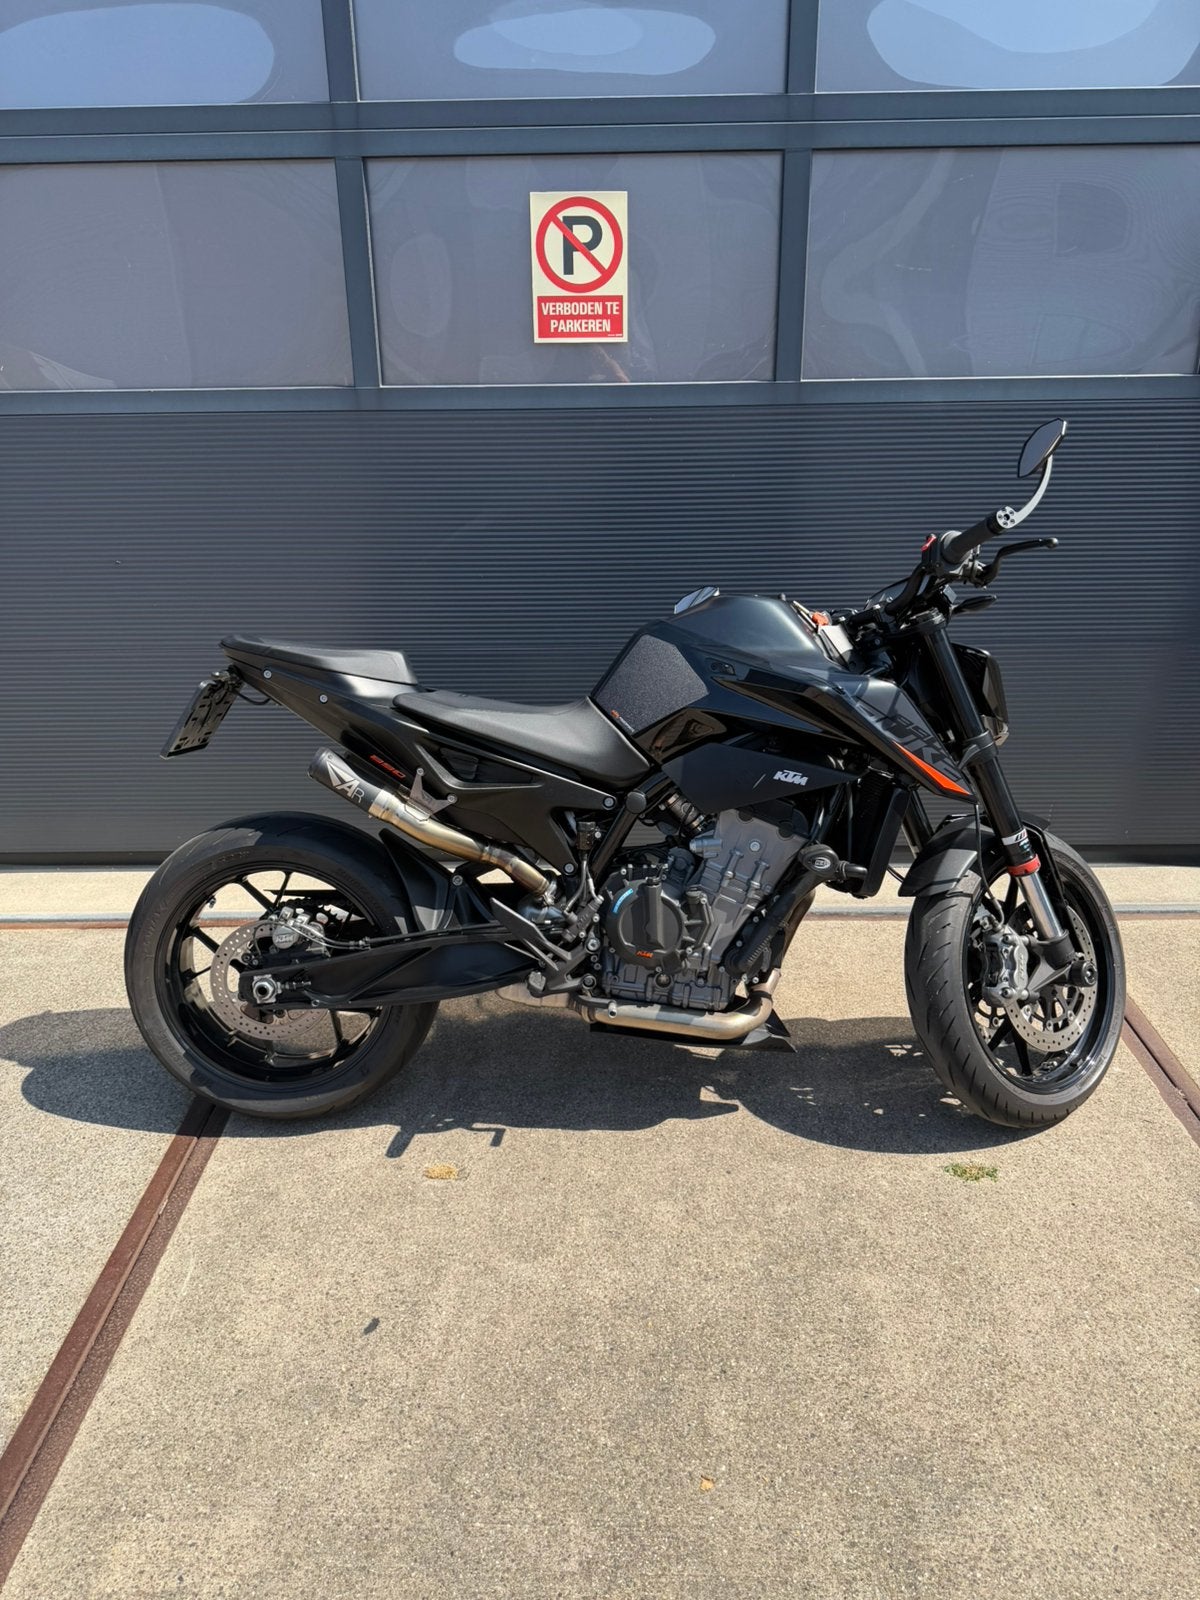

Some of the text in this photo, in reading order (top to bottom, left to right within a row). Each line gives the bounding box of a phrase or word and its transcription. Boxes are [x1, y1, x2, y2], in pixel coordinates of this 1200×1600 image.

[562, 215, 603, 275] P
[541, 301, 620, 316] VERBODEN TE
[550, 319, 611, 333] PARKEREN
[773, 769, 808, 786] KTM
